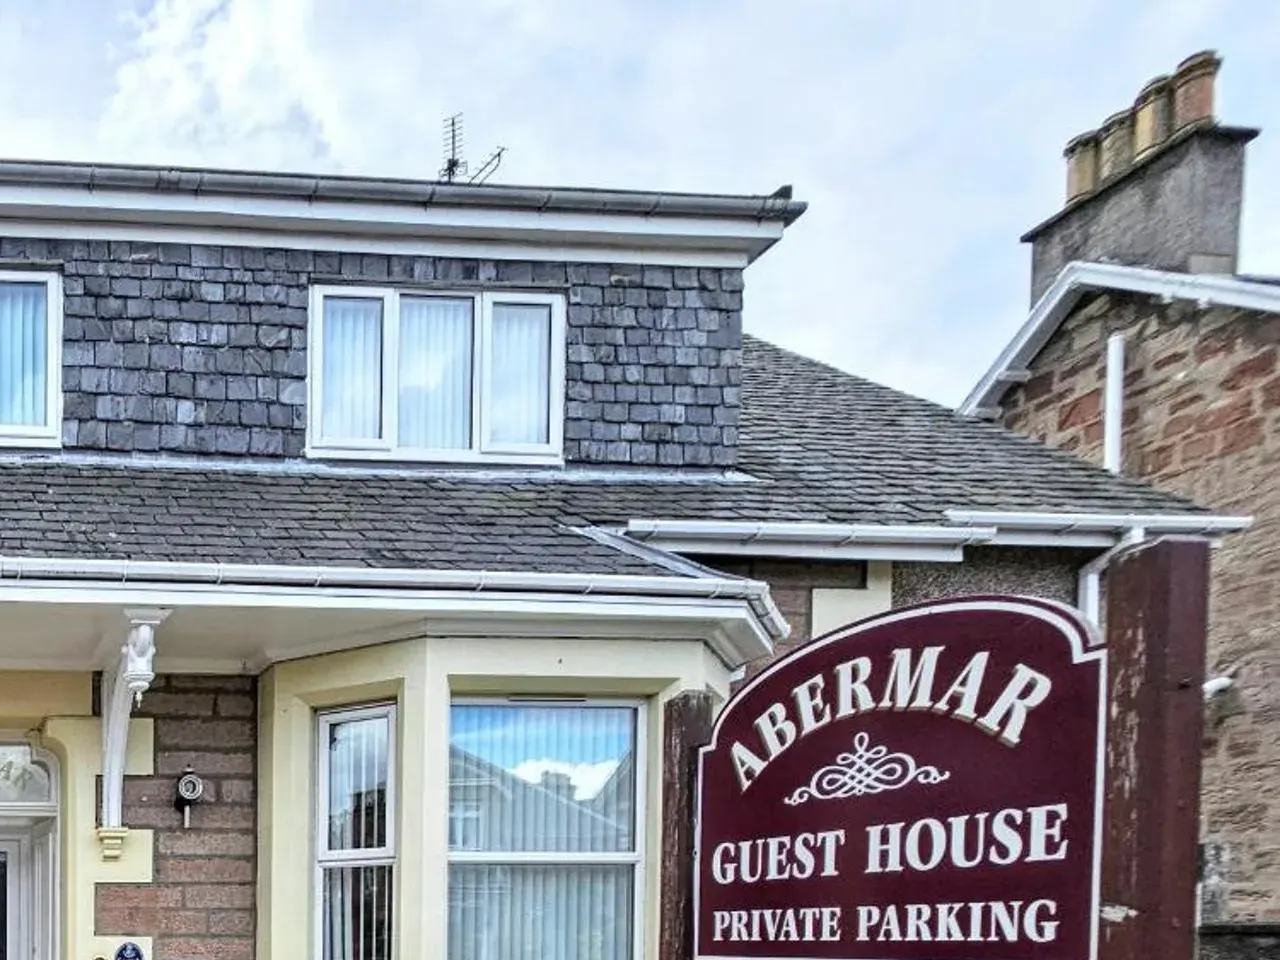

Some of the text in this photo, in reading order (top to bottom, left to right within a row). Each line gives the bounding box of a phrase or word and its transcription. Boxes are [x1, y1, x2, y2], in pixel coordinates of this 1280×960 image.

[729, 645, 1052, 794] ABERMAR
[711, 803, 1069, 885] GUEST HOUSE
[712, 898, 1060, 943] PRIVATE PARKING
